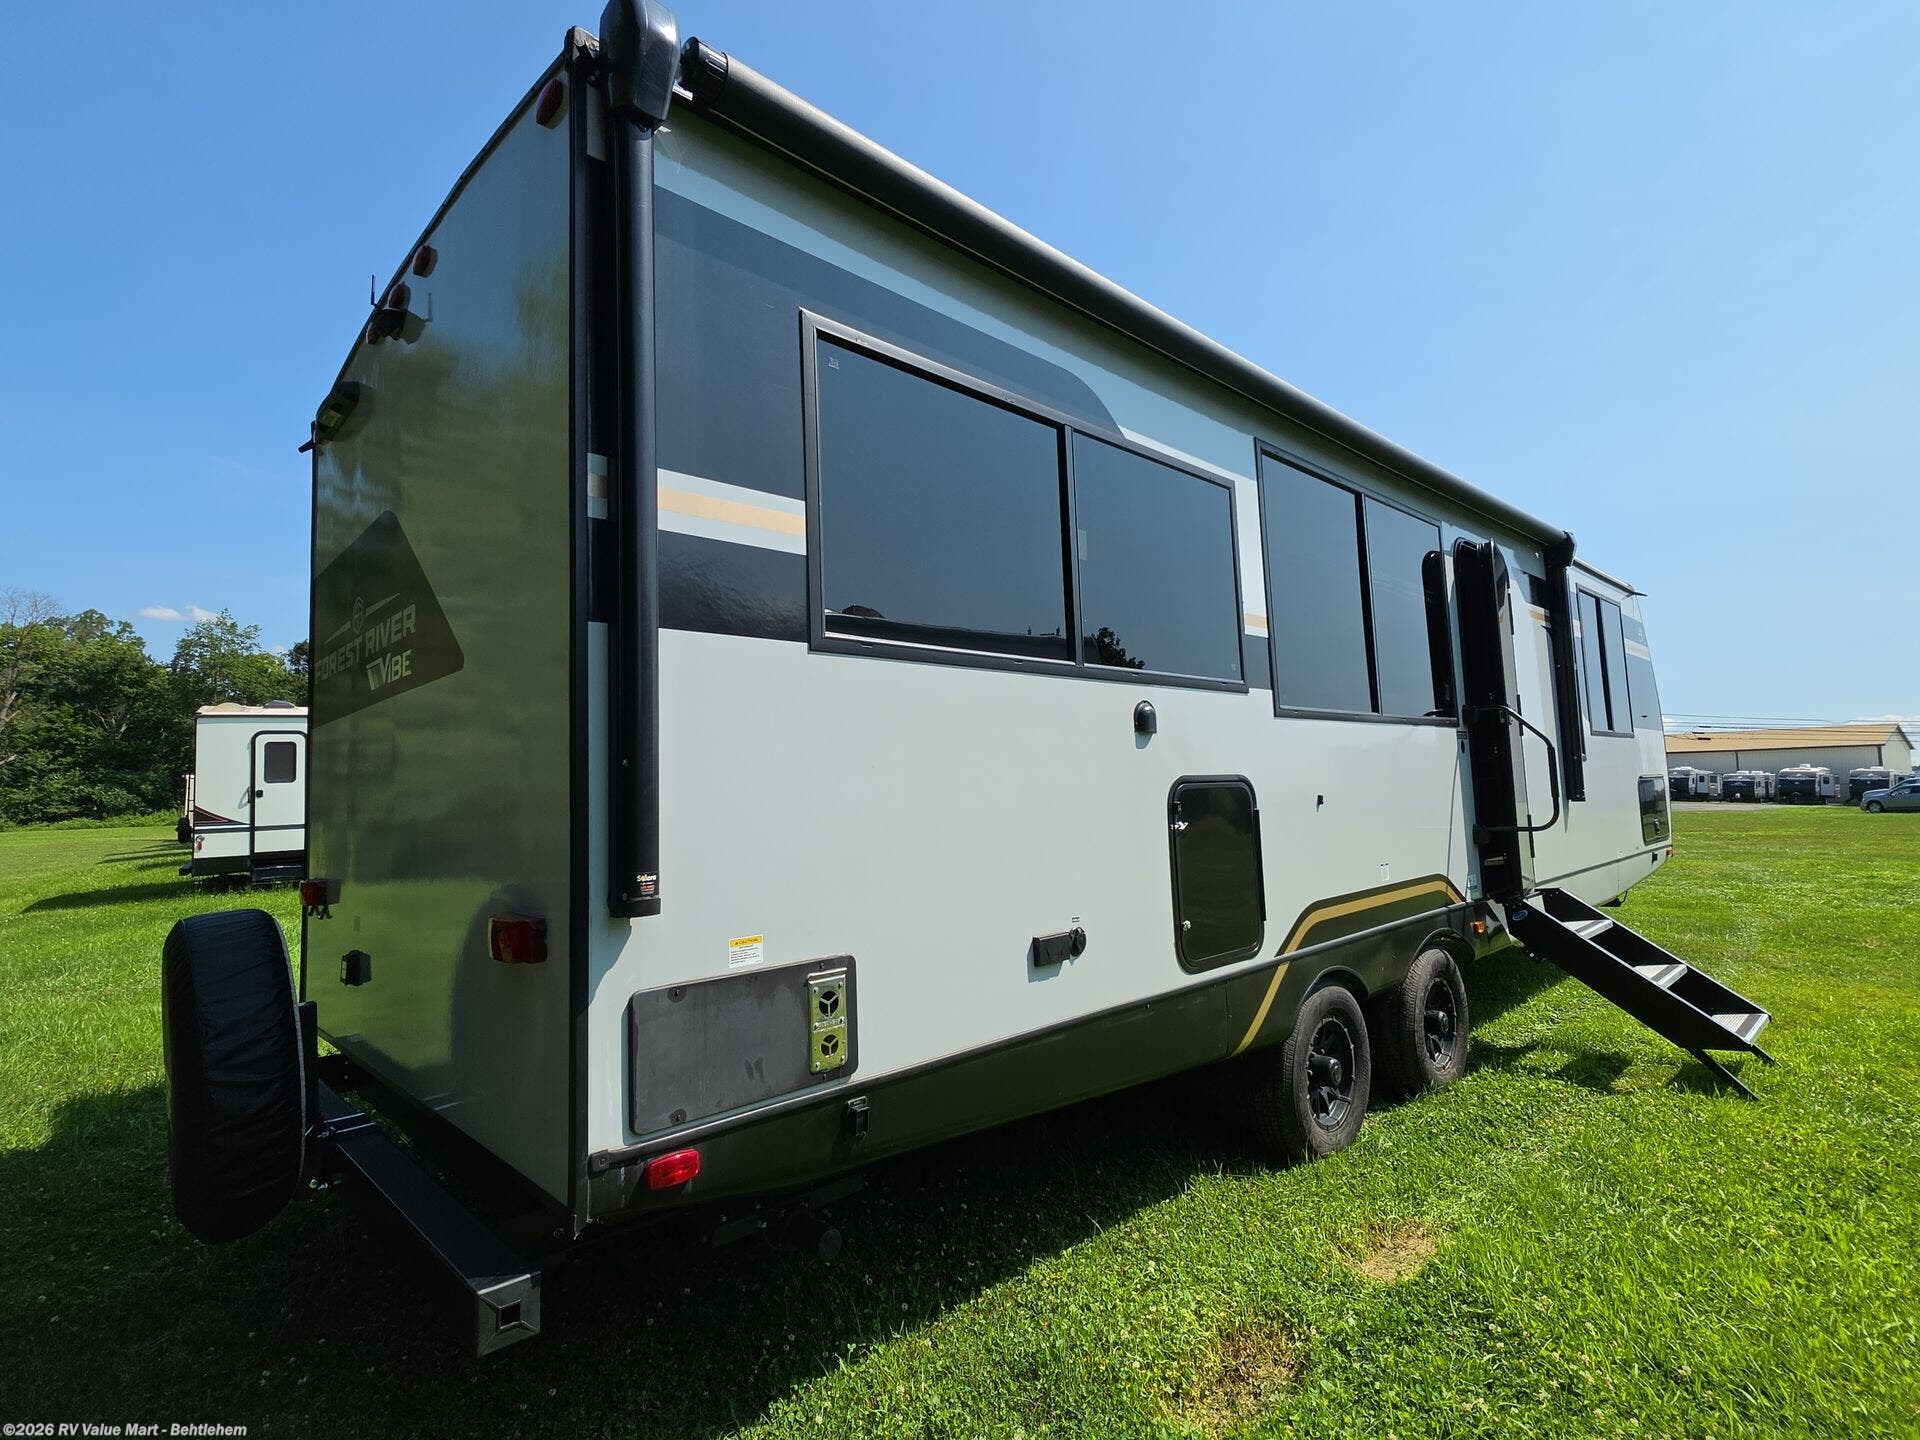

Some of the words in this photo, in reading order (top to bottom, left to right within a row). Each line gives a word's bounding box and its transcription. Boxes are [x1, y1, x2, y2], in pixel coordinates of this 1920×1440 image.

[314, 635, 362, 685] FOREST
[366, 603, 416, 657] RIVER
[366, 649, 412, 690] VIBE
